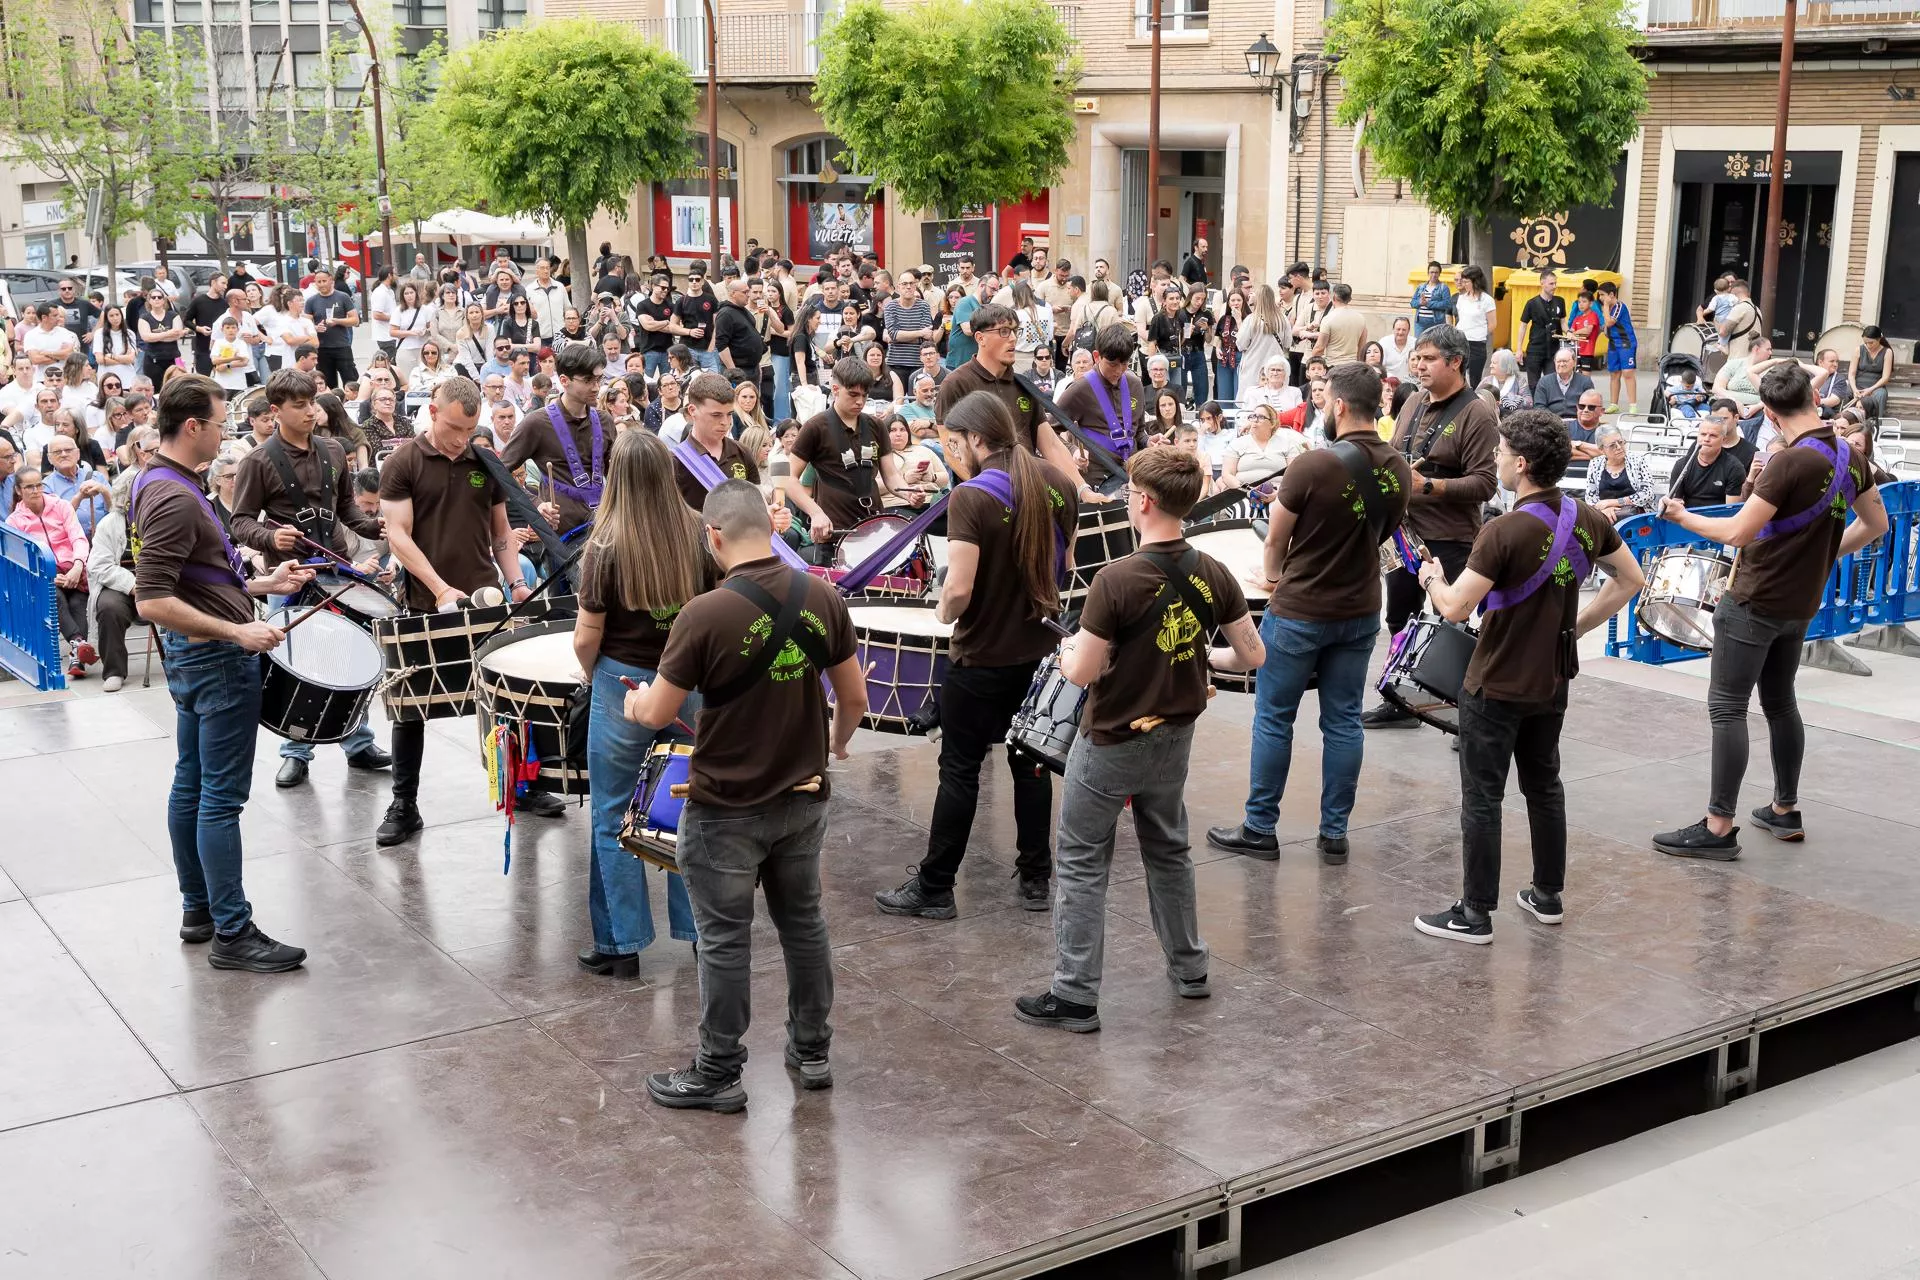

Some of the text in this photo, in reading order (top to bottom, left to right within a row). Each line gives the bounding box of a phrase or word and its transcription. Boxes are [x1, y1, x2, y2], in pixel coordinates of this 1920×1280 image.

[1754, 154, 1793, 172] ala
[815, 229, 866, 245] VUELTAS
[289, 258, 296, 268] P
[1628, 357, 1635, 366] 5
[1188, 574, 1213, 604] AMBORS
[800, 609, 827, 636] AMBORS
[770, 662, 810, 681] VILA-REL
